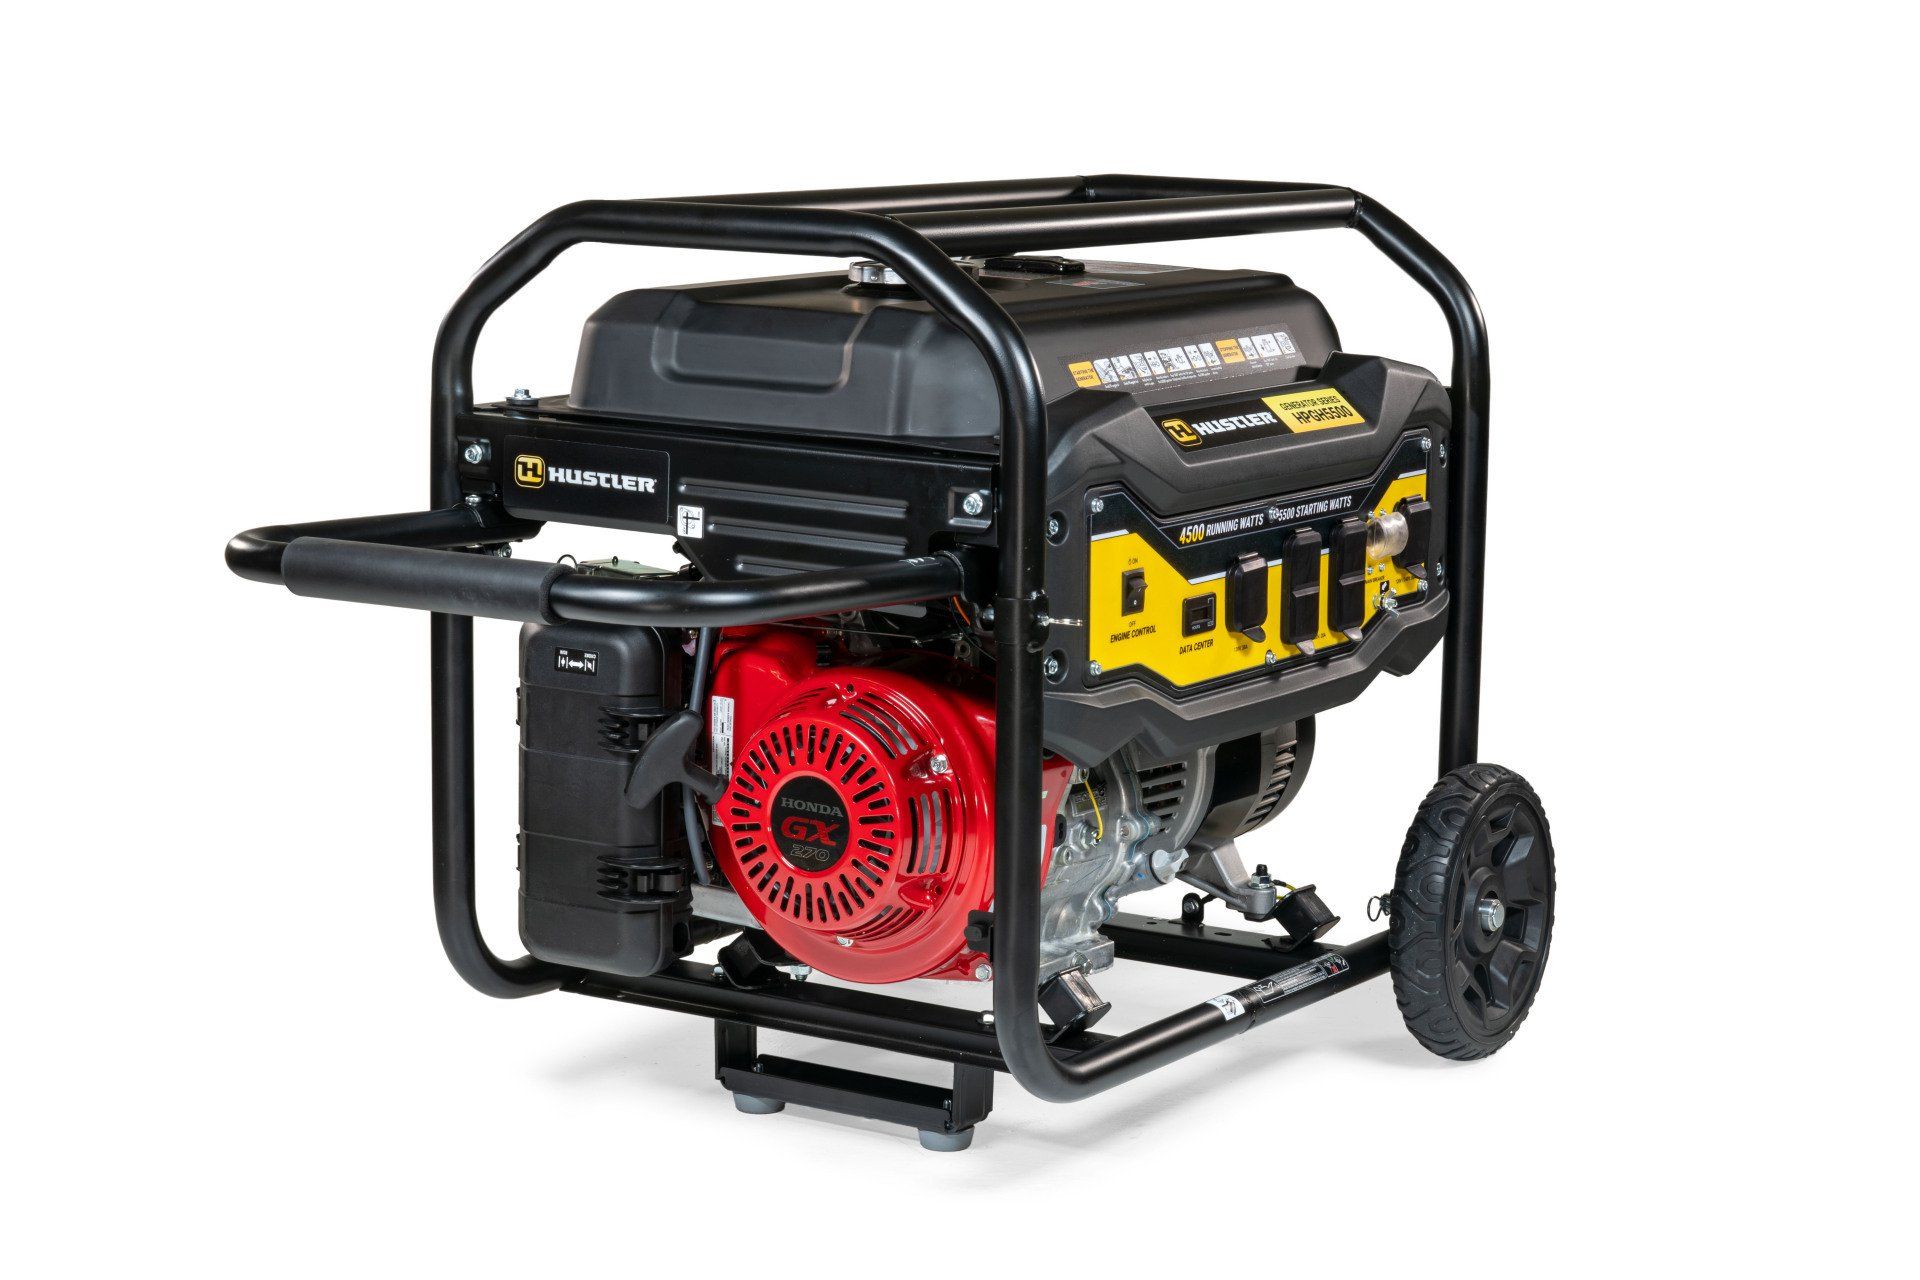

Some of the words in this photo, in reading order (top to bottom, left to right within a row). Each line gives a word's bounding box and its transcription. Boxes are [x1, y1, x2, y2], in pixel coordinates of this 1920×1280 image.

[1279, 398, 1317, 411] GENERATOR
[1317, 395, 1341, 405] SERIES
[1191, 411, 1278, 436] HUSTLER
[1291, 405, 1354, 424] HPGH5500
[548, 466, 656, 494] HUSTLER
[1278, 508, 1295, 522] 5500
[1295, 501, 1329, 518] STARTING
[1329, 496, 1352, 512] WATTS
[1179, 523, 1205, 545] 4500
[1206, 518, 1239, 537] RUNNING
[1239, 513, 1264, 530] WATTS
[1110, 631, 1131, 643] ENGINE
[1131, 625, 1157, 639] CONTROL
[1128, 620, 1137, 628] OFF
[1179, 643, 1193, 655] DATA
[1193, 639, 1214, 651] CENTER
[781, 797, 844, 818] HONDA
[781, 816, 840, 846] GX
[789, 843, 830, 862] 270
